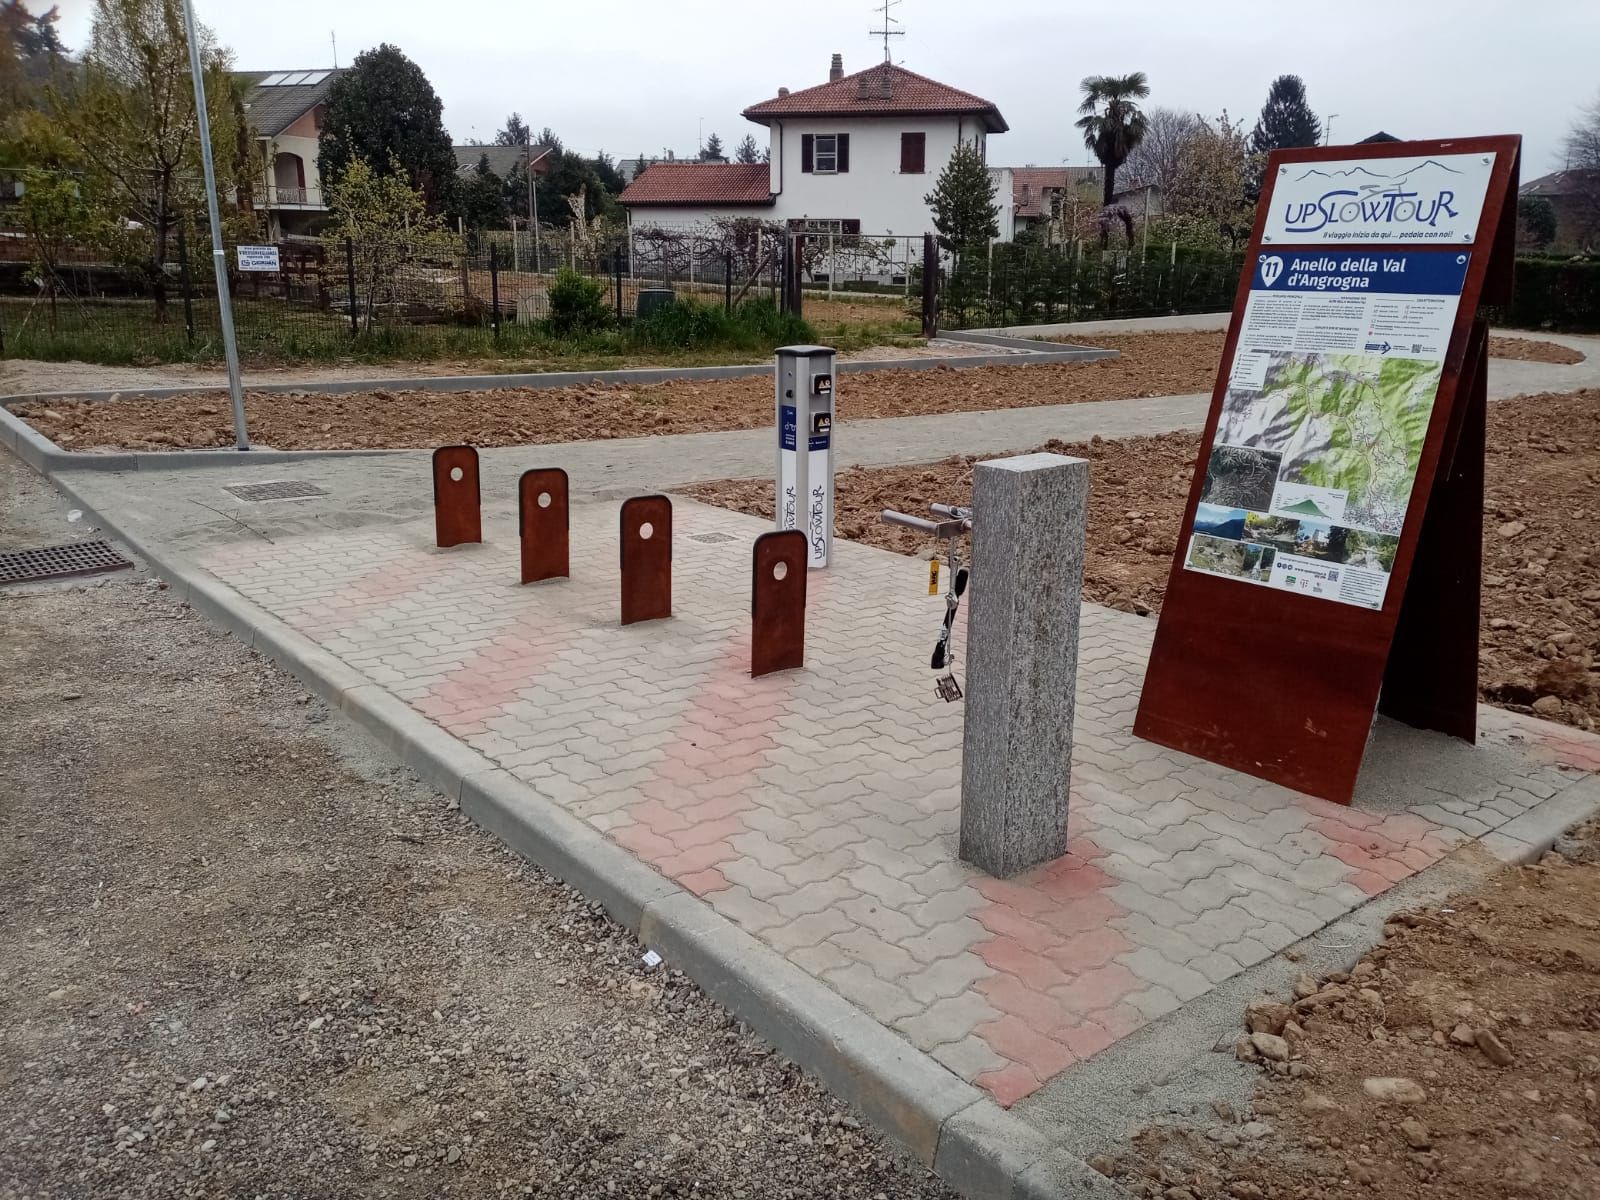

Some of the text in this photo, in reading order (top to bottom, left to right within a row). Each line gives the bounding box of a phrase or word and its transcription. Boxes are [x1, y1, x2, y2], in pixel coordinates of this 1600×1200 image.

[1328, 231, 1352, 240] viaggio
[1352, 231, 1369, 239] inizia
[1370, 231, 1380, 239] da
[1380, 231, 1391, 240] qui
[1399, 230, 1424, 239] pedala
[1265, 262, 1279, 277] 11
[1290, 258, 1406, 273] Anello della Val
[1287, 273, 1370, 290] d'Angrogna
